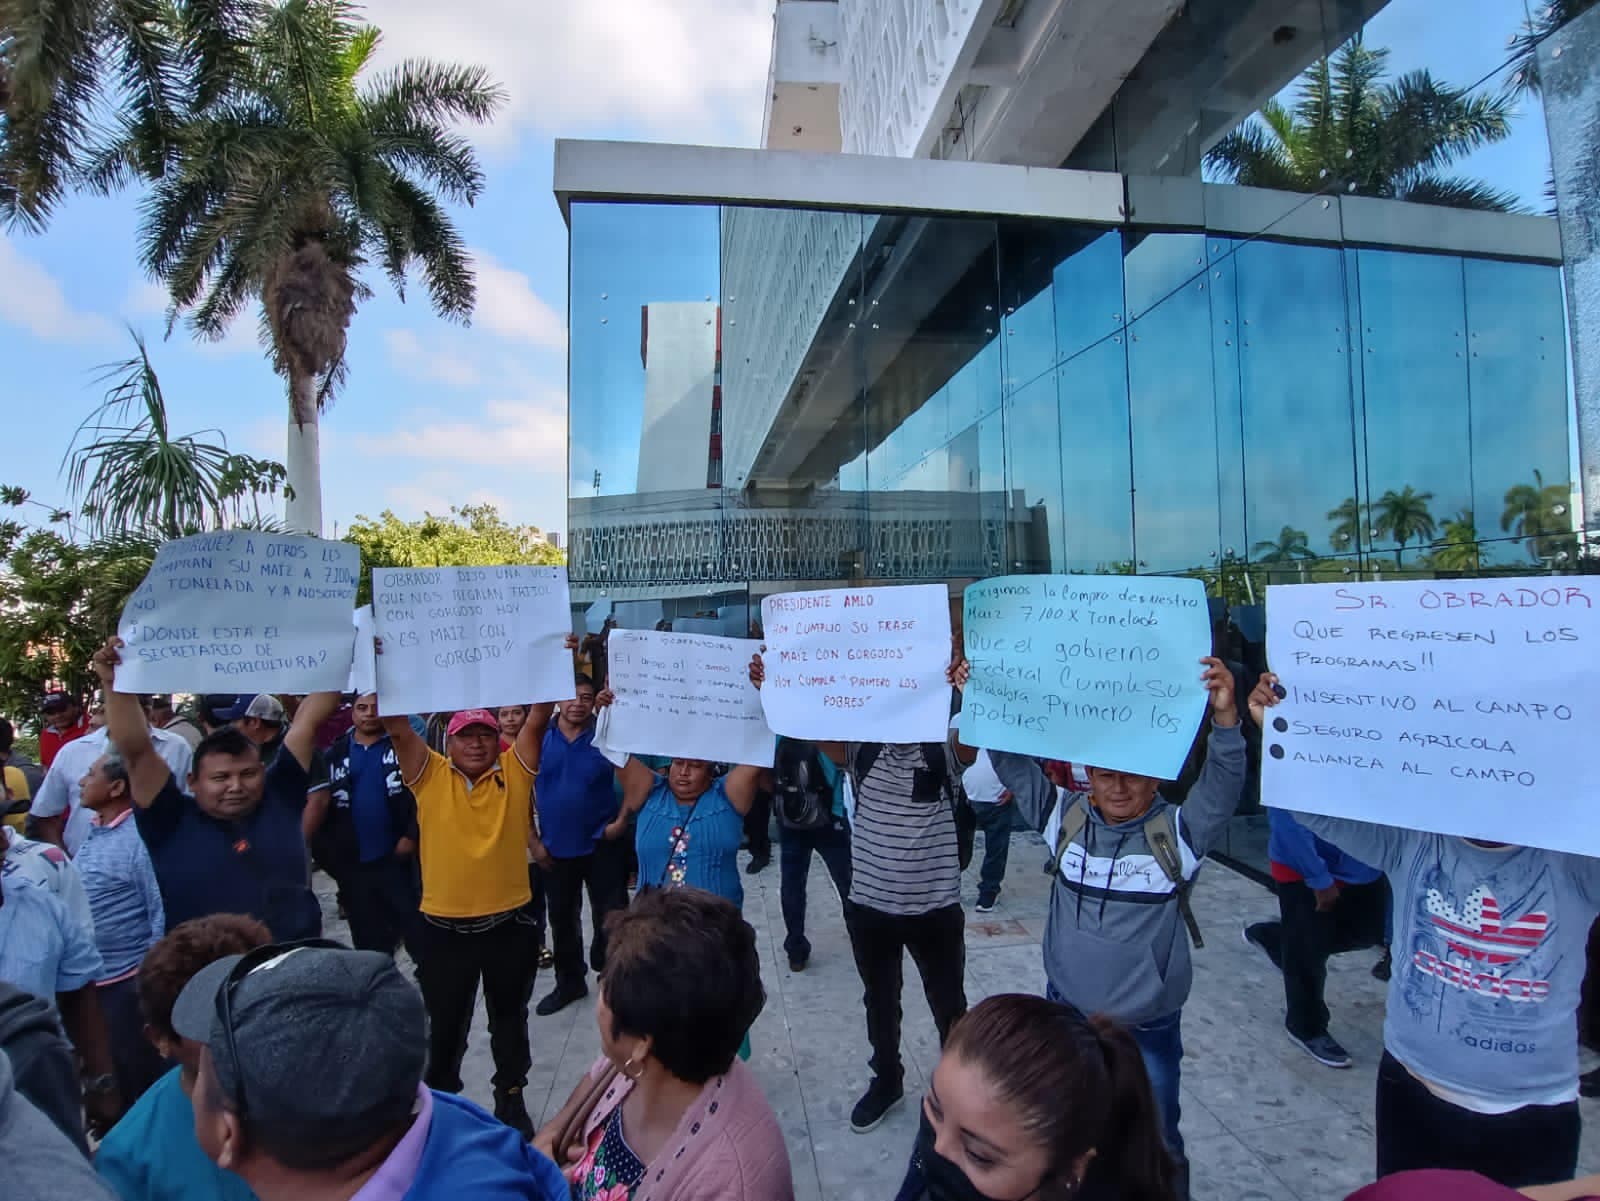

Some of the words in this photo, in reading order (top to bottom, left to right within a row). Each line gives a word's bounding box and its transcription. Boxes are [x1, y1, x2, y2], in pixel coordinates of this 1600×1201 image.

[245, 540, 256, 554] A
[265, 543, 308, 560] OTROS
[228, 560, 250, 573] SU
[303, 570, 312, 579] A
[382, 571, 442, 589] OBRADOR
[496, 568, 521, 580] UNA
[167, 576, 255, 593] TONELADA
[267, 586, 278, 598] Y
[283, 586, 292, 598] A
[768, 594, 833, 614] PRESIDENTE
[843, 594, 875, 609] AMLO
[1419, 586, 1593, 610] OBRADOR
[385, 609, 416, 623] CON
[264, 626, 281, 639] EL
[478, 623, 506, 639] CON
[849, 620, 869, 634] SU
[877, 620, 917, 633] FRASE
[1367, 626, 1497, 645] REGRESEN
[1525, 627, 1580, 644] LOS
[138, 645, 243, 664] SECRETARIO
[257, 643, 272, 657] DE
[815, 648, 840, 662] CON
[1055, 637, 1160, 664] gobierno
[213, 651, 328, 676] AGRICULTURA?
[1293, 685, 1417, 712] INSENTIVO
[1432, 699, 1465, 714] AL
[1475, 700, 1573, 722] CAMPO
[1291, 720, 1383, 742] SEGURO
[1398, 730, 1516, 755] AGRICOLA
[1292, 750, 1385, 770] ALIANZA
[1400, 762, 1433, 777] AL
[1449, 765, 1537, 787] CAMPO
[1414, 949, 1550, 1003] adidas
[1464, 1034, 1537, 1054] adidas
